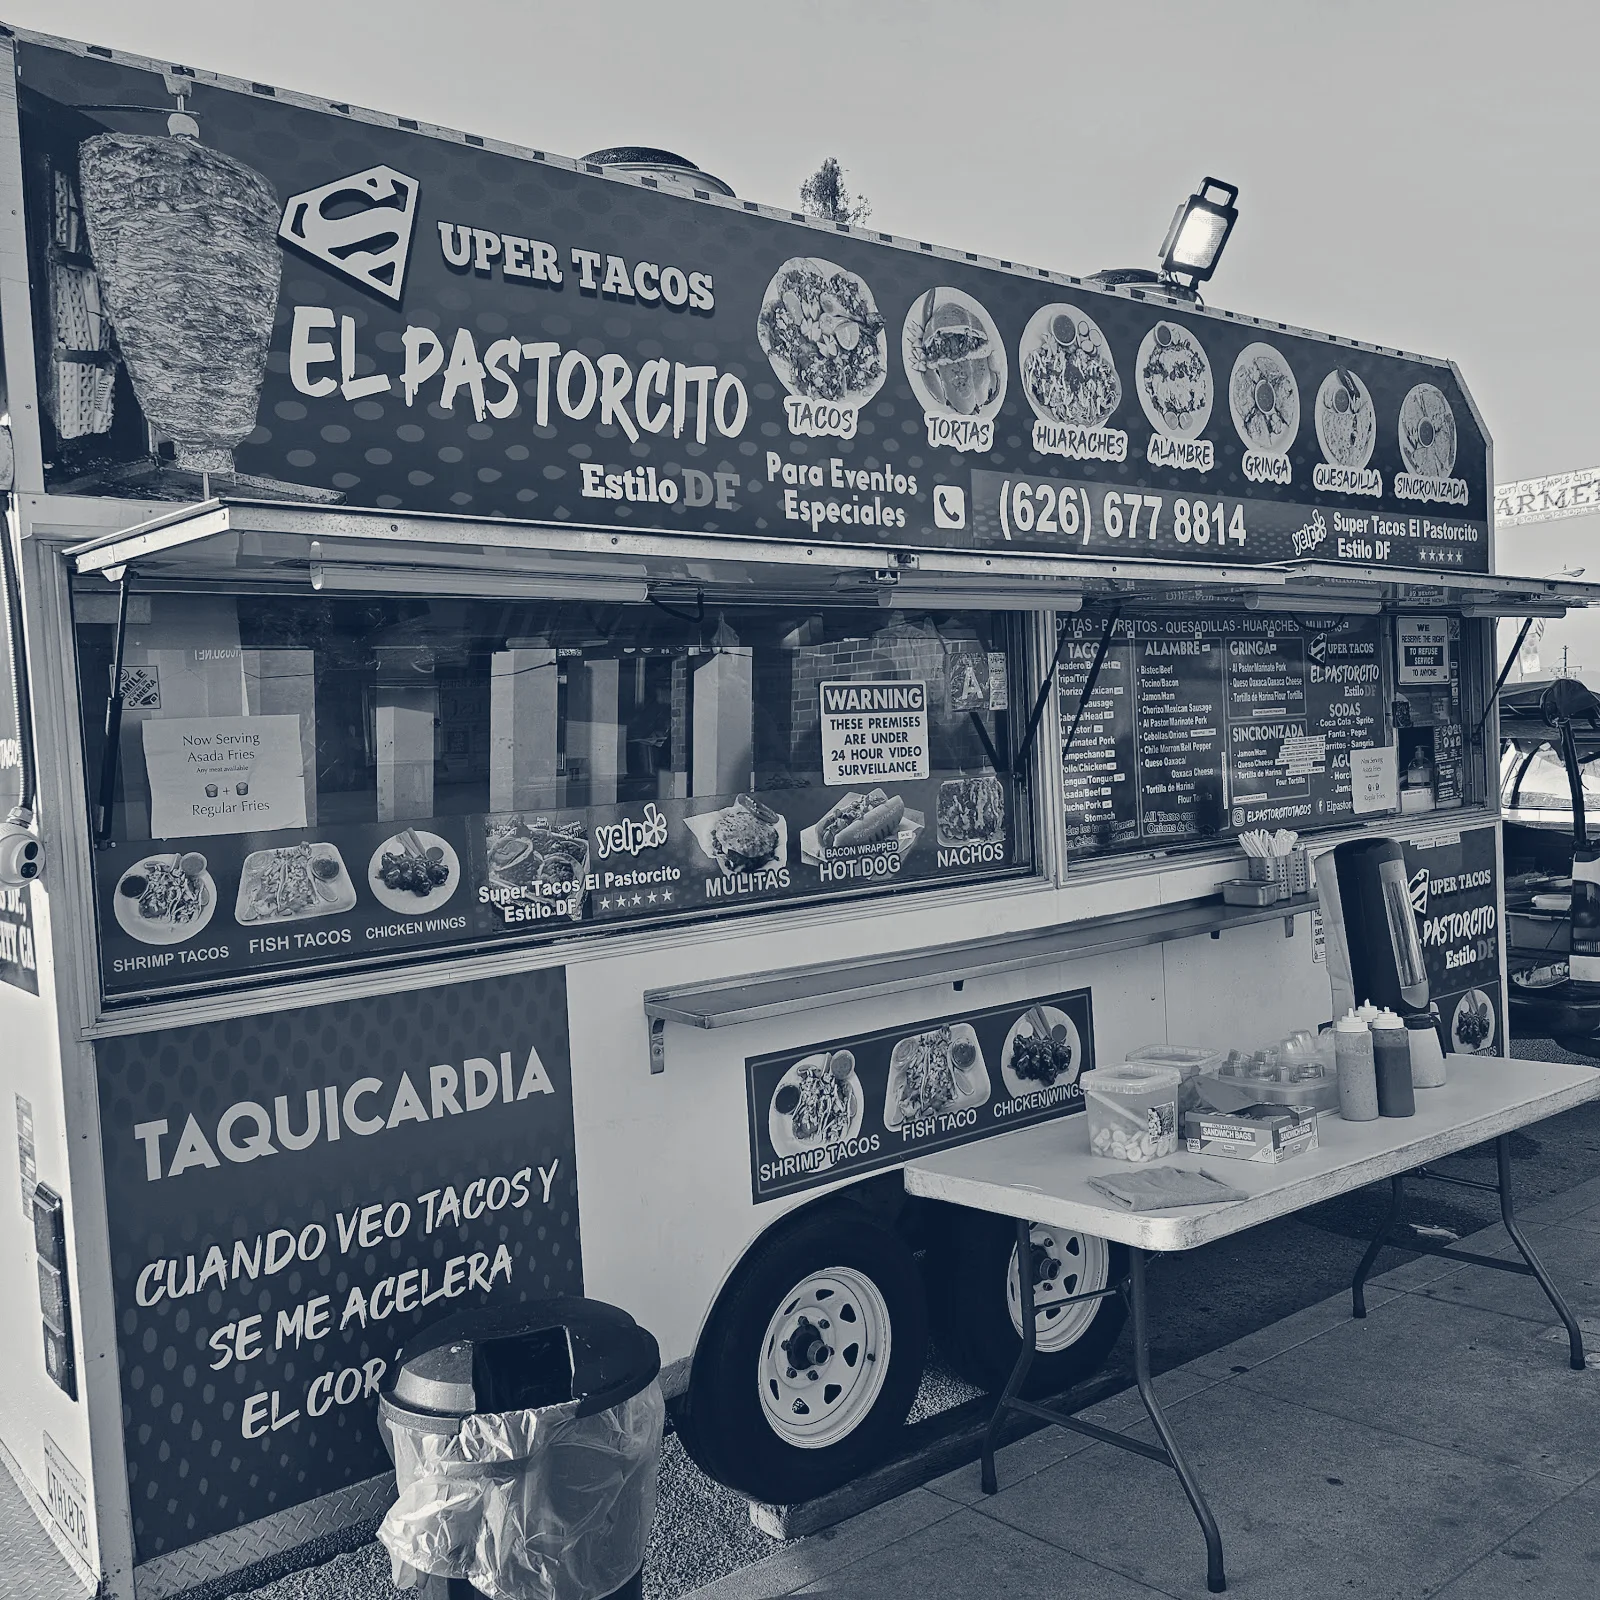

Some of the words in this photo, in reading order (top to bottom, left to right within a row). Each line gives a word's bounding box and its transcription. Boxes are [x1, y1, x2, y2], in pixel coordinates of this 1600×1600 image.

[571, 246, 714, 311] TACOS
[290, 306, 391, 401] EL
[400, 325, 748, 444] PASTORCITO
[789, 403, 853, 433] TACOS
[929, 416, 990, 446] TORTAS
[1036, 425, 1124, 457] HUARACHES
[1151, 440, 1211, 466] ALAMBRE
[766, 451, 824, 487] Para
[830, 458, 918, 496] Eventos
[1245, 455, 1289, 478] GRINGA
[580, 463, 678, 504] Estilo
[681, 468, 740, 511] DF
[1316, 467, 1380, 493] QUESADILLA
[1396, 477, 1468, 500] SINCRONIZADA
[1495, 479, 1600, 516] ARME
[784, 489, 905, 533] Especiales
[1000, 480, 1092, 545] (626)
[1103, 490, 1163, 540] 677
[1174, 498, 1247, 546] 8814
[1292, 513, 1323, 556] yelp
[1333, 512, 1369, 534] Super
[1371, 516, 1406, 537] Tacos
[1409, 519, 1421, 538] El
[1423, 521, 1478, 542] Pastorcito
[1337, 537, 1373, 560] Estilo
[1375, 540, 1391, 561] DF
[1166, 620, 1236, 634] QUESADILLAS
[1243, 620, 1299, 632] HUARACHES
[1417, 623, 1430, 632] WE
[1068, 642, 1108, 659] TACO
[1145, 641, 1200, 656] ALAMBRE
[1230, 641, 1271, 656] GRINGA
[1349, 643, 1374, 654] TACOS
[1432, 635, 1445, 643] RIGHT
[1414, 657, 1434, 665] SERVICE
[1418, 647, 1438, 655] REFUSE
[119, 670, 145, 697] SMILE
[962, 667, 984, 699] A
[1311, 665, 1324, 683] EL
[1325, 664, 1379, 684] PASTORCITO
[128, 679, 157, 707] CAMERA
[825, 688, 923, 711] WARNING
[1344, 685, 1364, 697] Estilo
[1189, 703, 1212, 713] Sausage
[1329, 702, 1361, 717] SODAS
[830, 718, 864, 730] THESE
[868, 716, 921, 728] PREMISES
[1194, 716, 1208, 725] Pork
[1320, 719, 1336, 727] Coca
[1337, 718, 1351, 726] Cola
[1355, 716, 1374, 726] Sprite
[182, 735, 211, 746] Now
[216, 733, 260, 746] Serving
[844, 733, 867, 745] ARE
[871, 732, 909, 744] UNDER
[1232, 724, 1304, 742] SINCRONIZADA
[1328, 730, 1346, 738] Fanta
[1351, 728, 1367, 737] Pepsi
[1351, 739, 1374, 749] Sangria
[187, 751, 223, 763] Asada
[228, 749, 255, 761] Fries
[831, 750, 846, 761] 24
[851, 748, 884, 761] HOUR
[888, 746, 922, 759] VIDEO
[1192, 742, 1212, 752] Pepper
[223, 764, 248, 772] available
[838, 761, 917, 777] SURVEILLANCE
[1144, 758, 1163, 768] Queso
[1171, 769, 1192, 778] Oaxaca
[1193, 768, 1213, 777] Cheese
[1238, 770, 1256, 779] Tortilla
[1146, 784, 1167, 794] Tortilla
[1288, 776, 1306, 785] Tortilla
[192, 803, 237, 817] Regular
[241, 801, 270, 813] Fries
[1085, 811, 1115, 822] Stomach
[596, 808, 662, 858] yelp
[825, 844, 856, 858] BACON
[856, 840, 898, 855] WRAPPED
[937, 844, 1004, 868] NACHOS
[819, 861, 859, 883] HOT
[860, 855, 901, 877] DOG
[1459, 869, 1491, 887] TACOS
[479, 885, 527, 904] Super
[532, 879, 581, 897] Tacos
[584, 873, 600, 891] El
[604, 866, 681, 889] Pastorcito
[705, 868, 791, 898] MULITAS
[504, 903, 551, 923] Estilo
[556, 899, 577, 915] DF
[366, 921, 423, 940] CHICKEN
[425, 916, 466, 931] WINGS
[1423, 905, 1495, 948] PASTORCITO
[19, 925, 35, 970] CA
[249, 936, 289, 954] FISH
[294, 928, 352, 949] TACOS
[113, 953, 174, 972] SHRIMP
[177, 946, 229, 964] TACOS
[1446, 945, 1476, 970] Estilo
[1477, 938, 1496, 961] DF
[993, 1091, 1048, 1118] CHICKEN
[1048, 1081, 1085, 1105] WINGS
[134, 1045, 556, 1182] TAQUICARDIA
[902, 1118, 936, 1142] FISH
[939, 1109, 977, 1131] TACO
[1203, 1127, 1235, 1139] SANDWICH
[1235, 1130, 1252, 1141] BAGS
[1281, 1128, 1300, 1142] SANDWICH
[1301, 1123, 1310, 1135] BAGS
[760, 1150, 825, 1182] SHRIMP
[826, 1134, 880, 1163] TACOS
[135, 1223, 327, 1308] CUANDO
[335, 1202, 411, 1255] VEO
[417, 1166, 533, 1234] TACOS
[537, 1158, 559, 1203] Y
[209, 1314, 263, 1371] SE
[275, 1294, 331, 1353] ME
[339, 1243, 513, 1332] ACELERA
[241, 1390, 301, 1440] EL
[306, 1352, 397, 1417] COR
